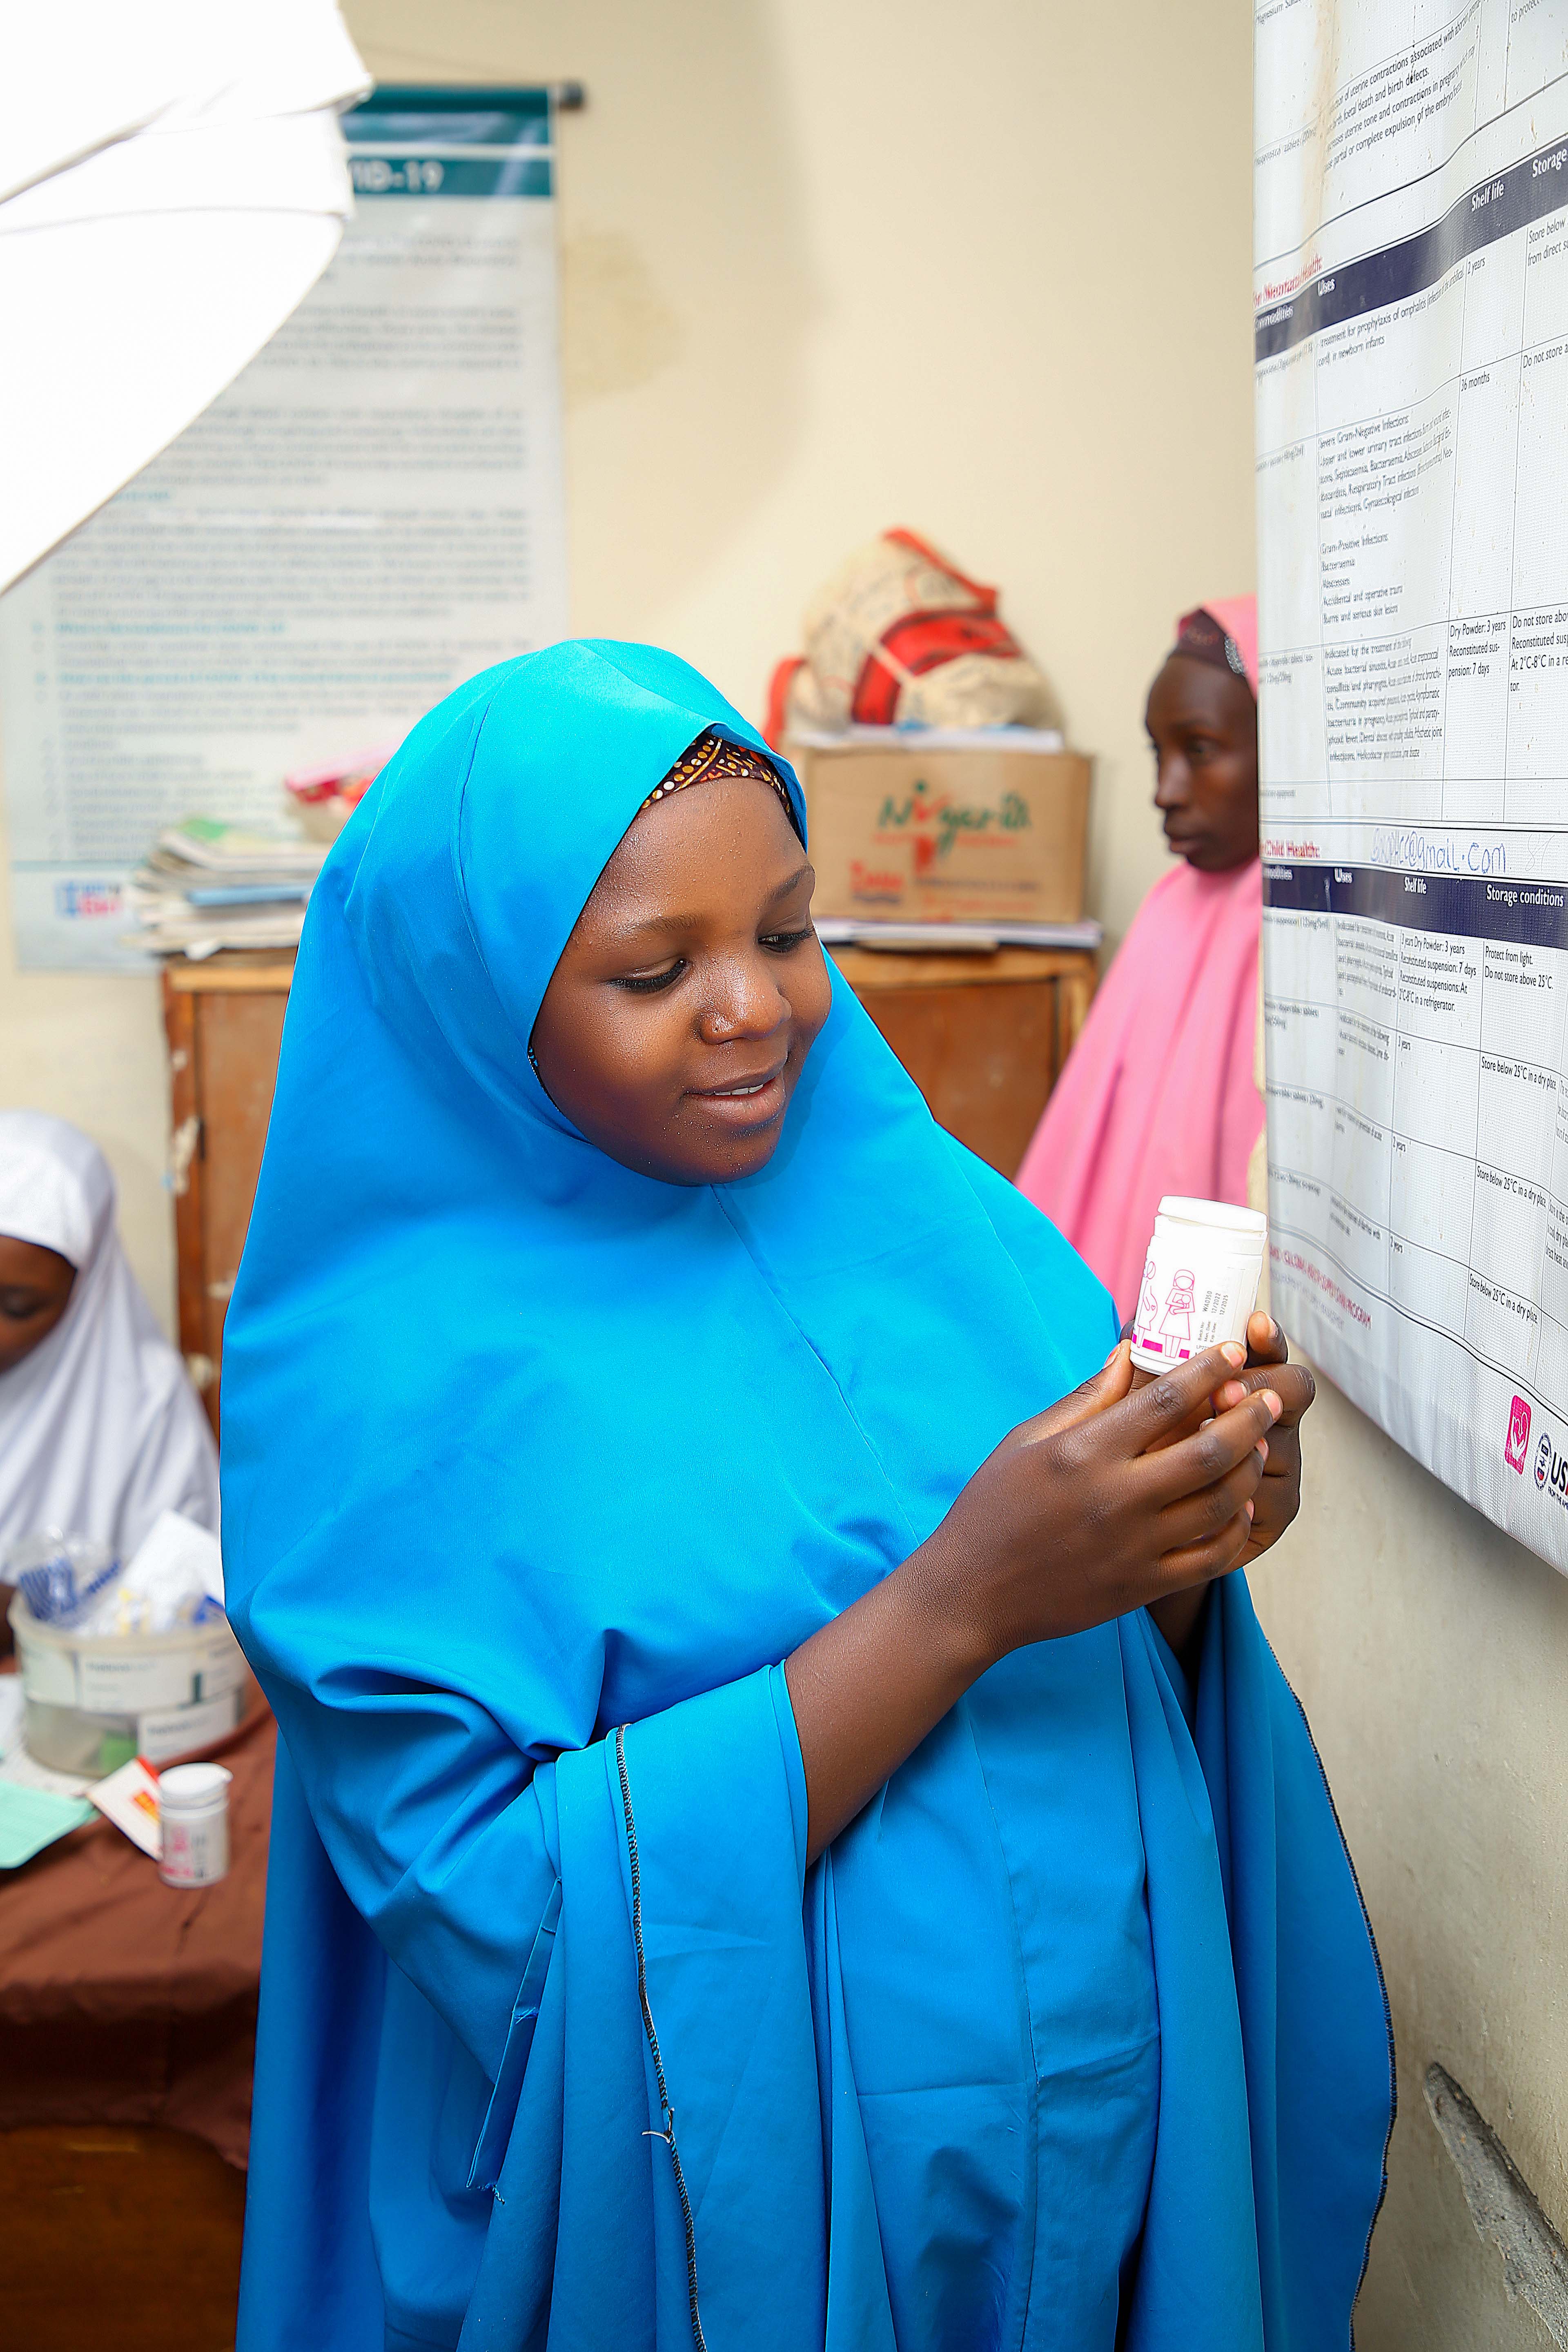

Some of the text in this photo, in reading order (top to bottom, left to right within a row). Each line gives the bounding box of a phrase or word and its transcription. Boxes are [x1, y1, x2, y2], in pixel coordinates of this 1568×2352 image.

[1370, 57, 1408, 85] contractions
[1410, 34, 1442, 64] associated
[1443, 26, 1454, 44] with
[1358, 94, 1373, 111] death
[1375, 85, 1386, 102] and
[1388, 77, 1403, 96] birth
[1364, 114, 1377, 128] tone
[1379, 103, 1390, 120] and
[1392, 86, 1431, 114] contractions
[1433, 81, 1438, 92] in
[1356, 131, 1383, 151] complete
[1385, 115, 1415, 137] expulsion
[1417, 107, 1423, 124] of
[1425, 104, 1434, 119] the
[348, 159, 444, 193] ID-19
[1471, 149, 1567, 212] Shelf life Storage
[1529, 228, 1544, 244] Store
[1547, 218, 1566, 235] below
[1528, 252, 1541, 266] from
[1544, 242, 1561, 258] direct
[1471, 257, 1485, 276] years
[1317, 278, 1336, 297] Uses
[1523, 355, 1532, 368] Do
[1534, 352, 1544, 364] not
[1546, 346, 1562, 360] store
[1461, 371, 1490, 392] 36 months
[1450, 620, 1506, 640] Dry Powder: 3 years
[1513, 616, 1521, 628] Do
[1523, 616, 1534, 627] not
[1536, 615, 1552, 625] store
[1450, 641, 1499, 657] Reconstituted sus-
[1512, 632, 1554, 649] Reconstituted
[1448, 662, 1489, 681] pension: 7 days
[1511, 658, 1518, 670] At
[1520, 654, 1546, 670] 2°C-8°C
[1549, 655, 1554, 667] in
[1557, 657, 1559, 666] a
[1510, 683, 1519, 691] tor.
[1334, 867, 1564, 907] Uses Shelf life Storage conditions
[1414, 936, 1422, 952] Dry
[1423, 938, 1444, 952] Powder:
[1445, 941, 1448, 952] 3
[1450, 944, 1465, 956] years
[1486, 946, 1533, 967] Protect from light.
[1428, 961, 1458, 974] suspension:
[1459, 962, 1463, 973] 7
[1465, 963, 1476, 979] days
[1485, 966, 1553, 989] Do not store above 25°C.
[1415, 993, 1419, 1004] in
[1420, 997, 1422, 1005] a
[1424, 996, 1455, 1011] refrigerator.
[1482, 1057, 1496, 1071] Store
[1497, 1060, 1513, 1075] below
[1515, 1065, 1527, 1079] 25°C
[1529, 1070, 1532, 1081] in
[1534, 1074, 1537, 1082] a
[1538, 1072, 1546, 1089] dry
[1477, 1166, 1488, 1181] Store
[1490, 1171, 1503, 1187] below
[1504, 1177, 1517, 1193] 25°C
[1518, 1183, 1523, 1196] in
[1524, 1189, 1527, 1197] a
[1554, 1248, 1562, 1265] heat
[1203, 1291, 1212, 1312] WA0350
[1212, 1293, 1221, 1313] 12/2022
[1219, 1295, 1228, 1315] 12/2025
[1470, 1274, 1537, 1324] Store below 25°C in a dry place.
[1551, 1451, 1568, 1496] US
